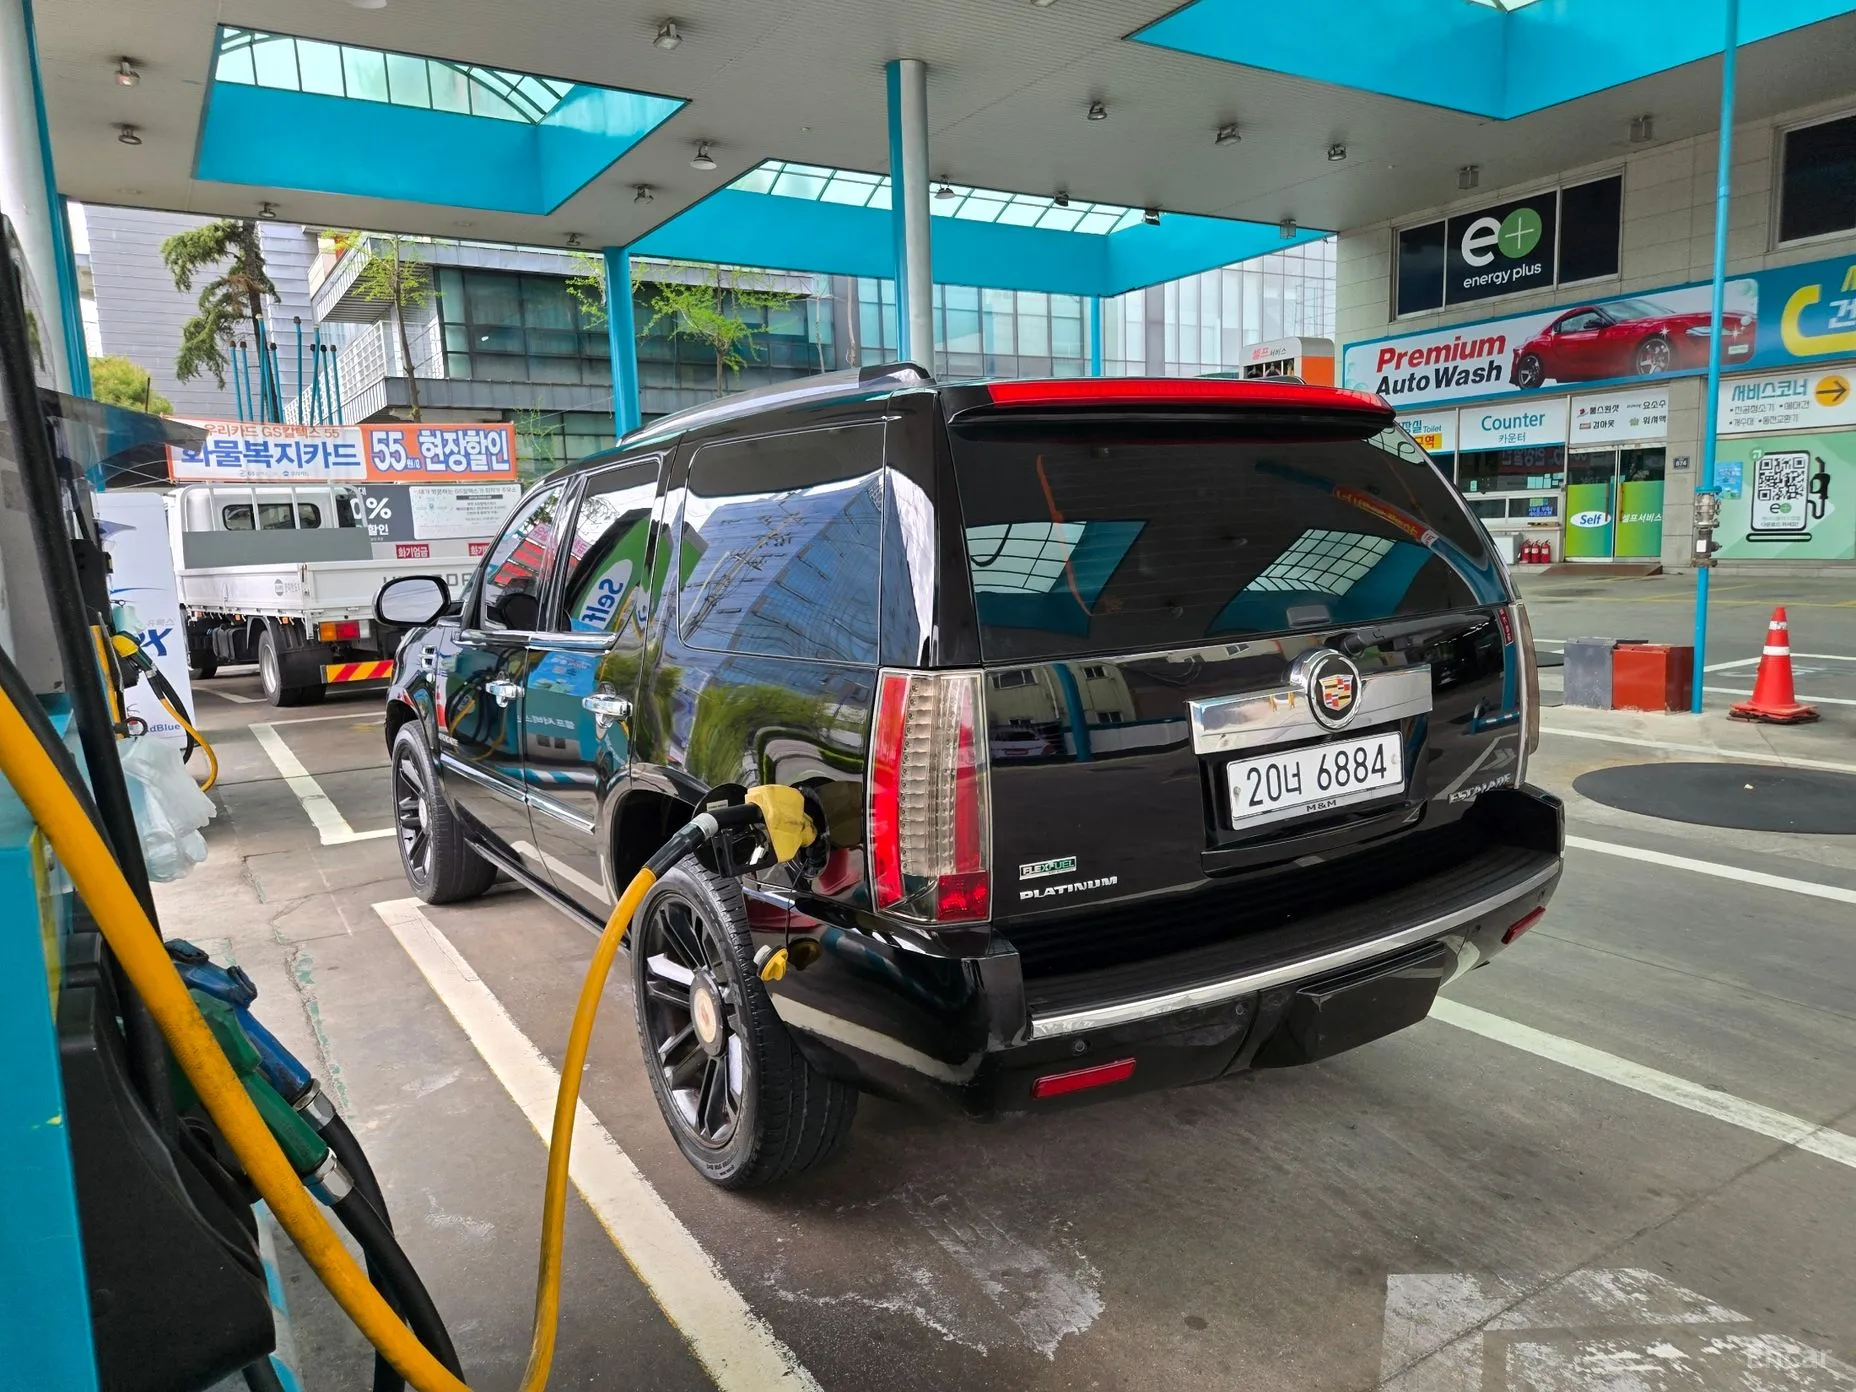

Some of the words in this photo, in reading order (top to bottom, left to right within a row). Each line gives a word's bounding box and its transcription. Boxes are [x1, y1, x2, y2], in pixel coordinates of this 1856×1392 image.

[1463, 269, 1511, 288] energy
[1512, 263, 1542, 281] plus
[1376, 335, 1507, 373] Premium
[1376, 372, 1430, 396] Auto
[1434, 359, 1503, 389] Wash
[1731, 379, 1808, 401] 서비스코너
[1643, 399, 1666, 410] 요소수
[1402, 419, 1422, 434] 장실
[1423, 424, 1442, 433] Toilet
[1481, 413, 1546, 432] Counter
[262, 426, 321, 439] GS칼텍스
[324, 429, 340, 438] 55
[1498, 432, 1527, 444] 카운터
[181, 439, 361, 469] 화물복지카드
[417, 429, 510, 473] 현장할인
[1580, 514, 1602, 525] Self
[368, 524, 389, 536] 할인
[398, 546, 429, 558] 화기엄금
[470, 546, 487, 557] 화기
[149, 723, 181, 733] dBlue
[1246, 761, 1302, 808] 20너
[1317, 743, 1387, 791] 6884
[1306, 800, 1337, 812] M&M
[1022, 859, 1075, 875] FLEXFUEL
[1020, 876, 1118, 900] PLATINUM
